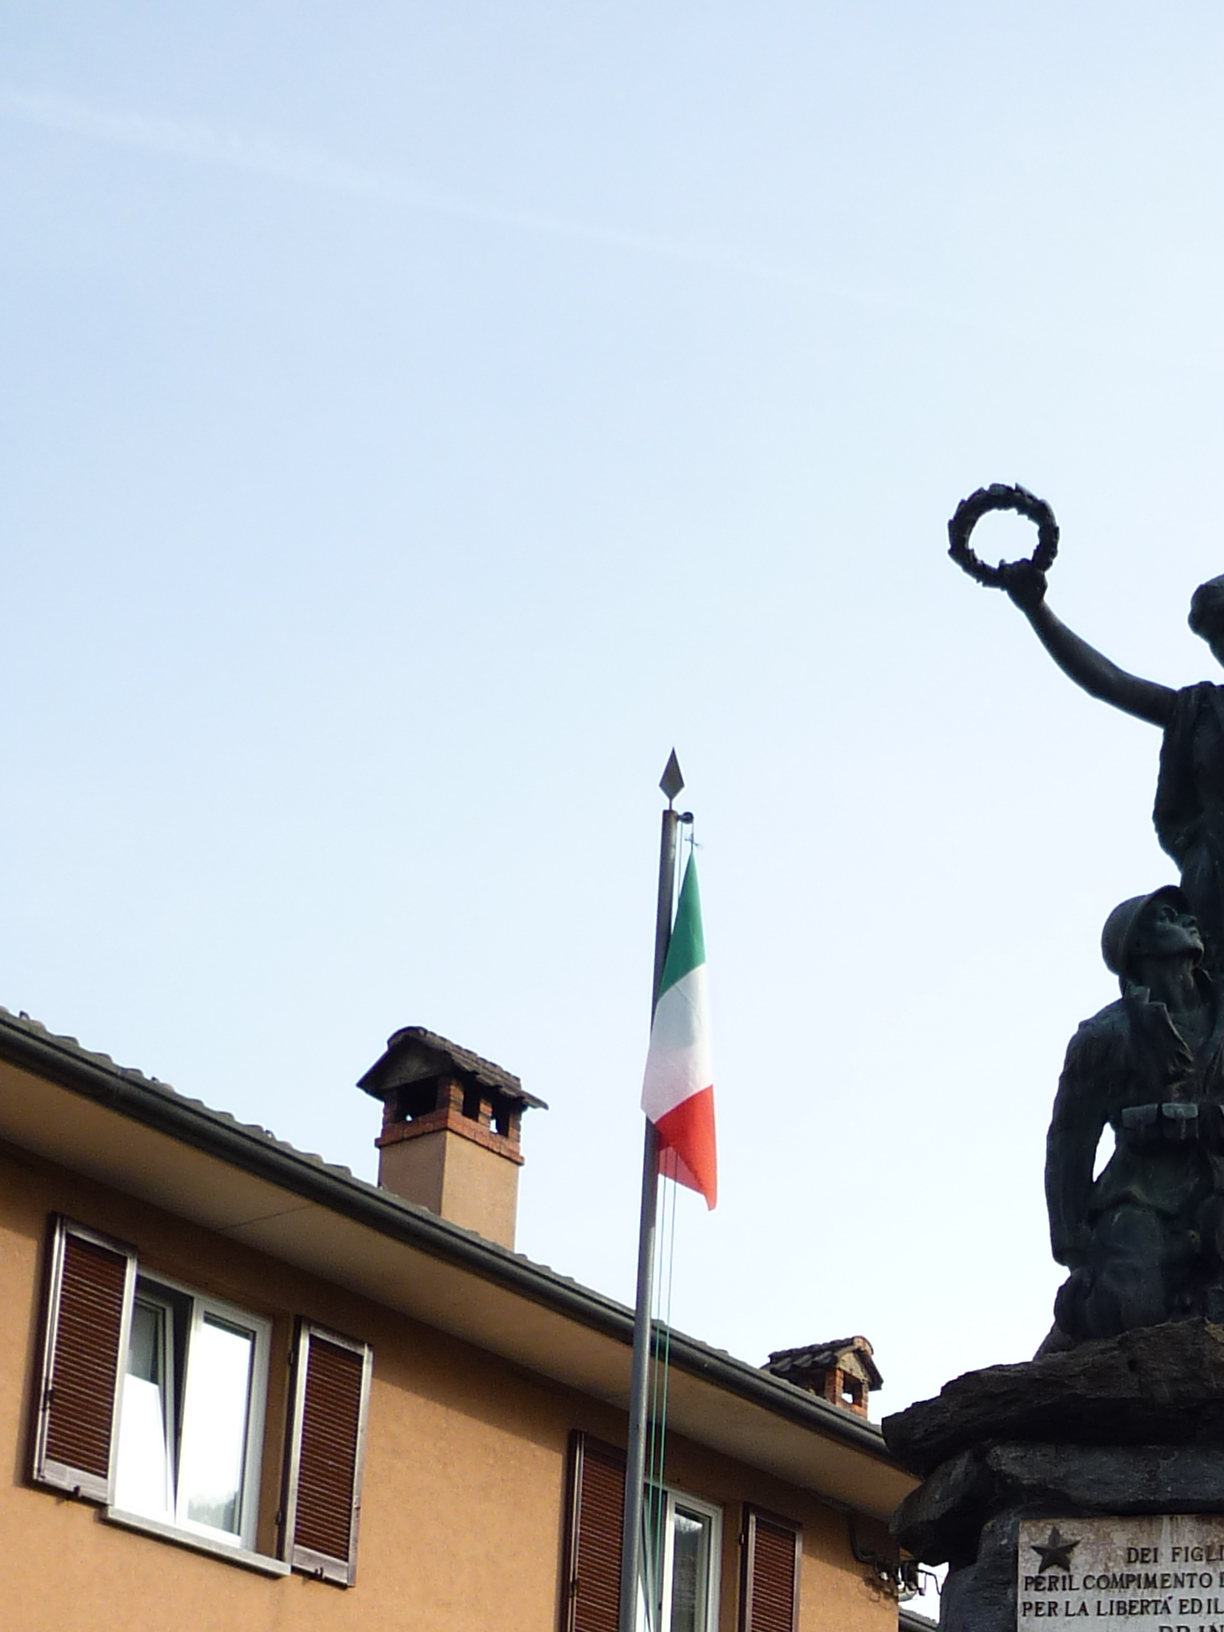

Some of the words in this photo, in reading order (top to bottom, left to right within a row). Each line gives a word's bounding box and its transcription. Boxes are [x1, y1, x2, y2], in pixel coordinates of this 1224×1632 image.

[1127, 1547, 1158, 1563] DEI
[1171, 1545, 1224, 1562] FIGLI
[1024, 1575, 1058, 1591] PER
[1062, 1575, 1079, 1591] IL
[1083, 1573, 1212, 1590] COMPIMENTO
[1022, 1601, 1058, 1617] PER
[1065, 1601, 1089, 1617] LA
[1179, 1598, 1202, 1615] ED
[1207, 1598, 1224, 1614] IL
